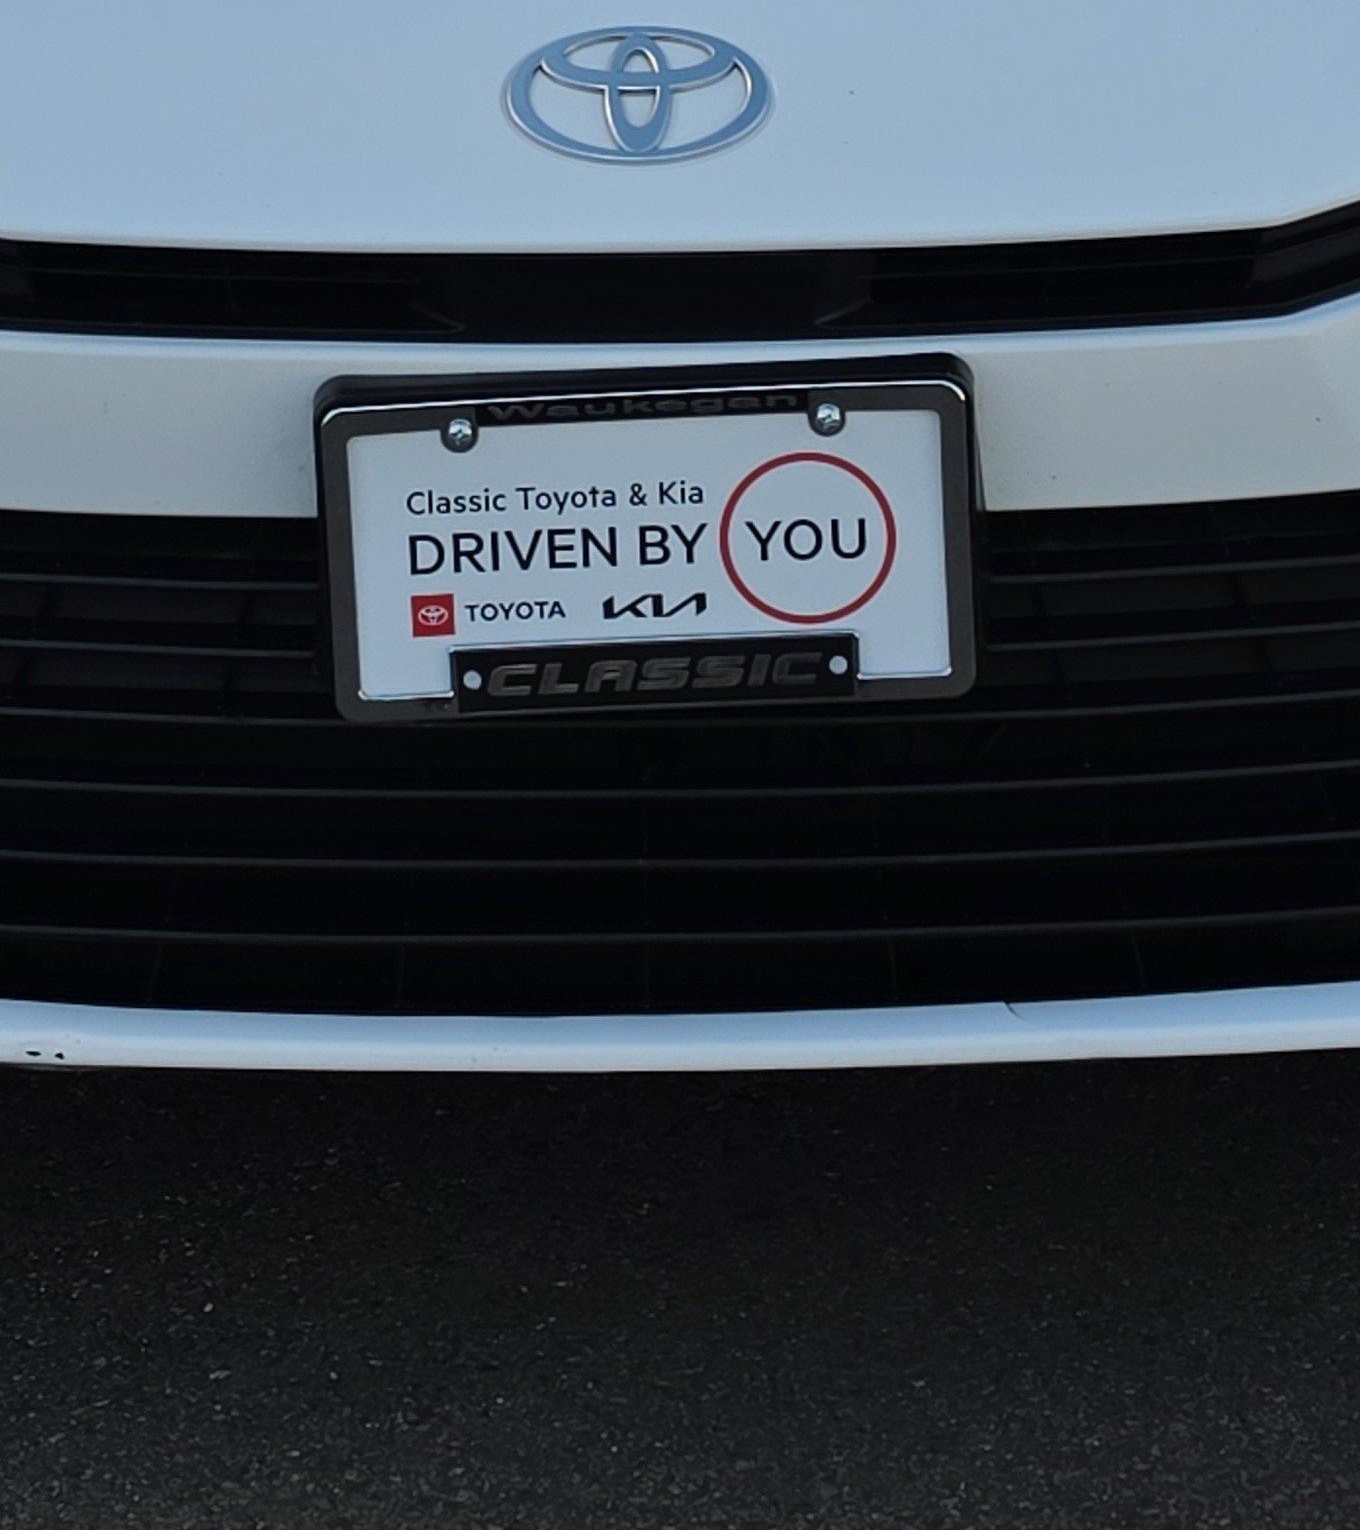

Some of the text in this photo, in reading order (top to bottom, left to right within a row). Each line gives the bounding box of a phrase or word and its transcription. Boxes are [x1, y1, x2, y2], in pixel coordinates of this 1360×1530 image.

[486, 393, 798, 420] Waukegan
[406, 480, 704, 516] Classic Toyota & Kia
[408, 518, 867, 576] DRIVEN BY YOU
[464, 600, 566, 622] TOYOTA
[486, 651, 823, 698] CLASSIC
